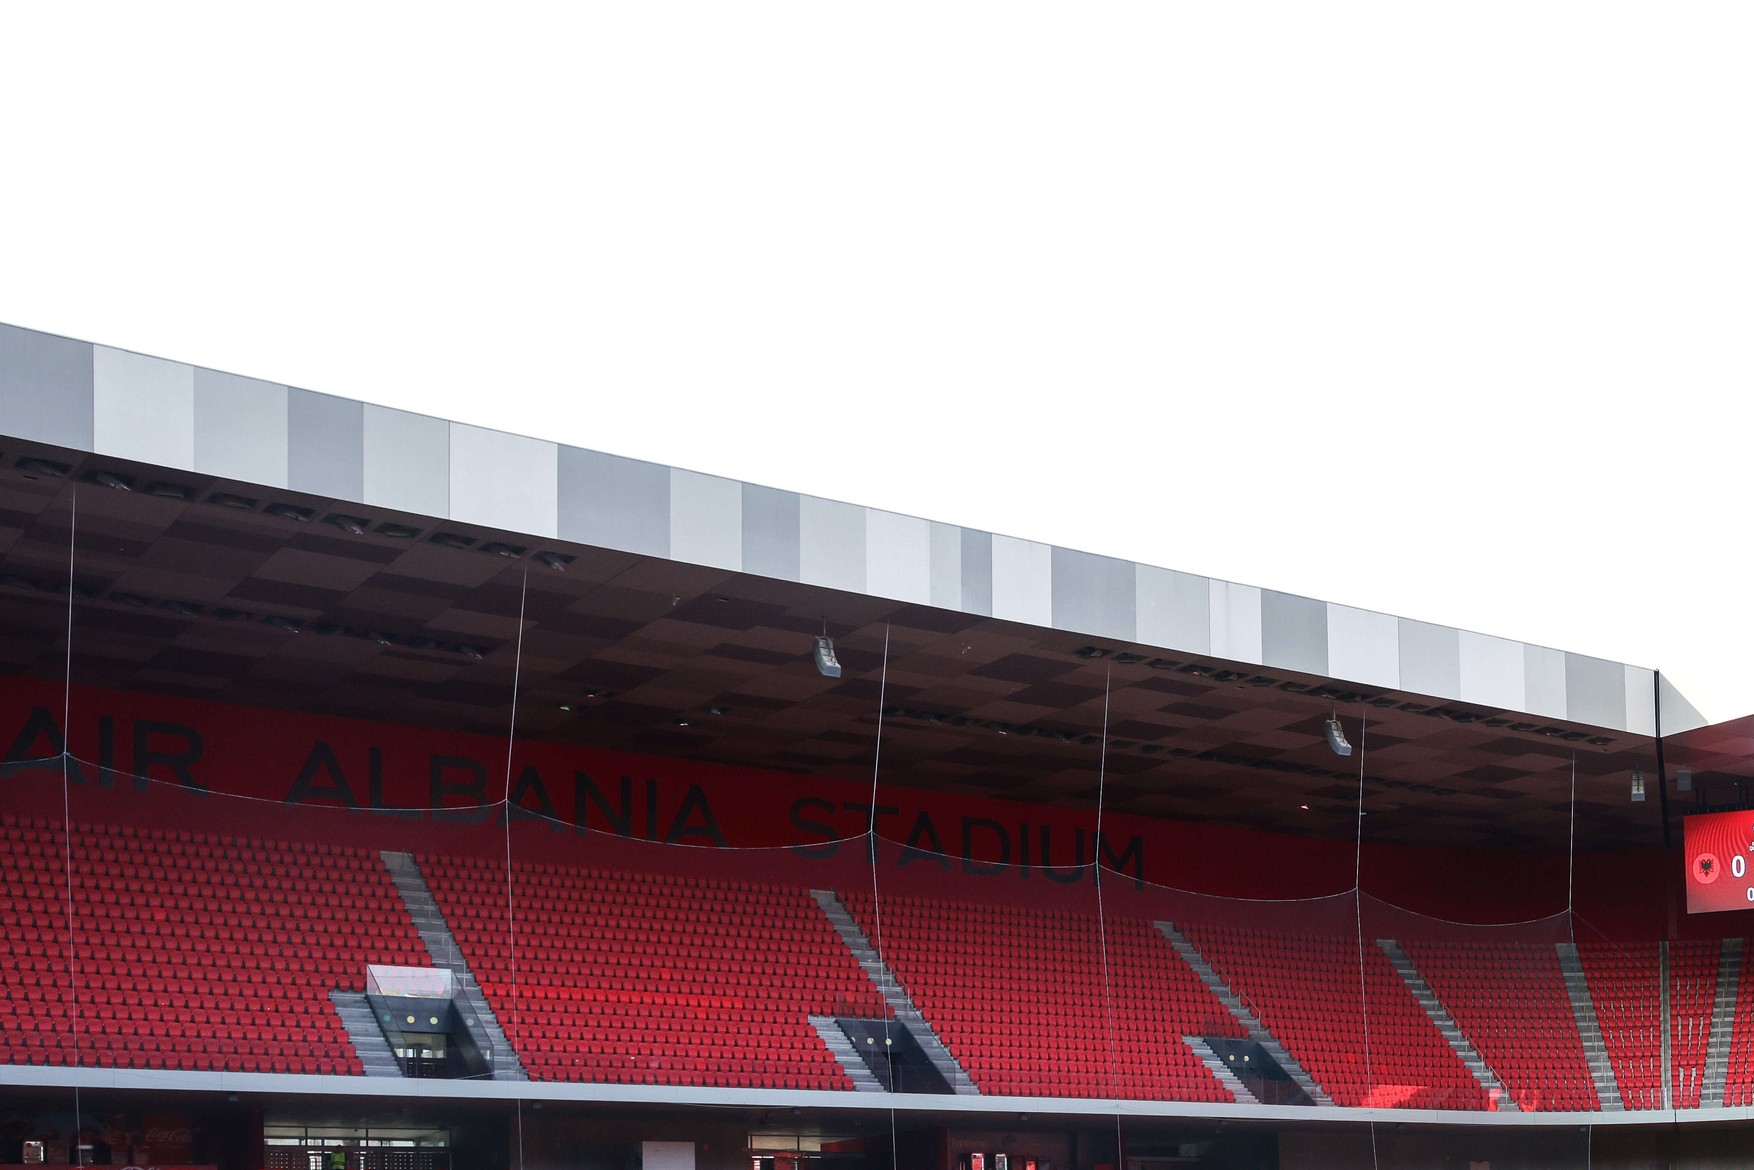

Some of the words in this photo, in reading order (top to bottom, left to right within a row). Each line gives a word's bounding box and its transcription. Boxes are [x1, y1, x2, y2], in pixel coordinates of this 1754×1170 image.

[1, 704, 210, 796] AIR
[284, 740, 728, 850] ALBANIA
[788, 797, 1145, 891] STADIUM
[1731, 854, 1746, 878] 0
